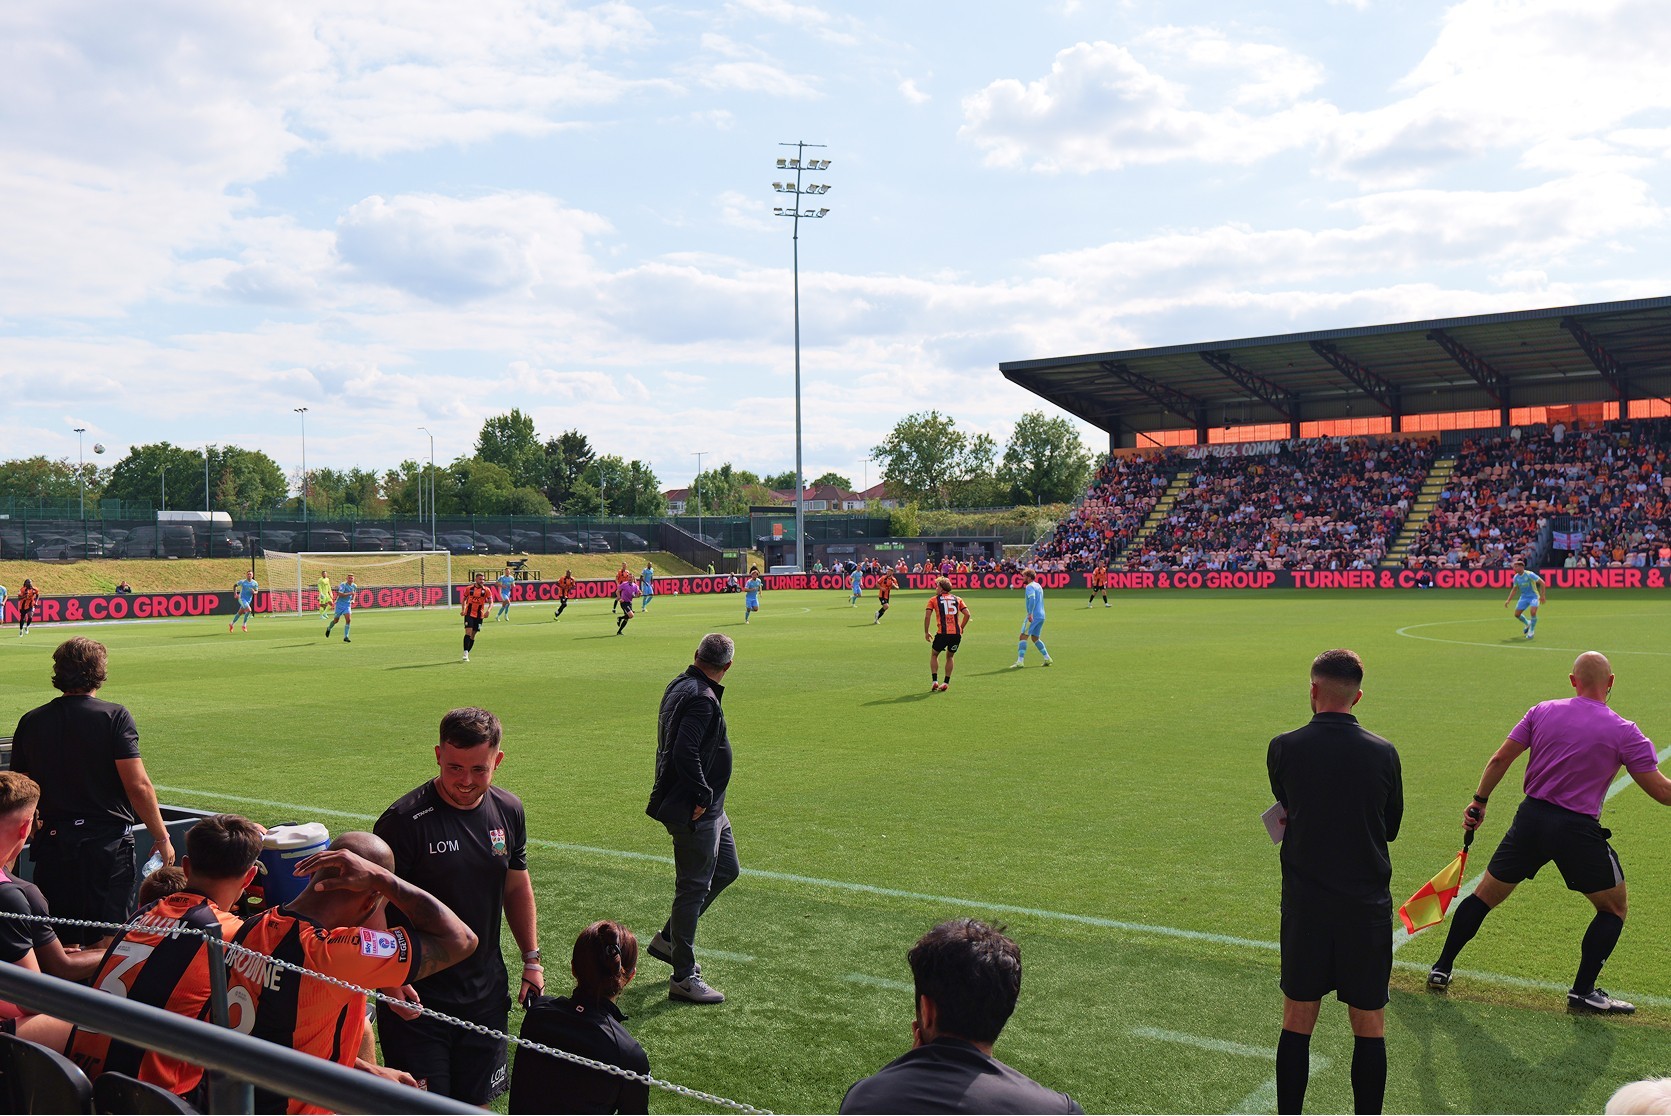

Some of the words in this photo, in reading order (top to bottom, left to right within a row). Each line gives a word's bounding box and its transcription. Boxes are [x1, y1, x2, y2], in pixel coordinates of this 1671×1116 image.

[682, 578, 691, 594] &
[693, 577, 712, 593] CO
[764, 575, 807, 590] TURNER
[810, 575, 819, 589] &
[821, 574, 842, 589] CO
[906, 573, 967, 589] TURER
[970, 573, 981, 589] &
[983, 573, 1008, 589] CO
[1011, 572, 1070, 589] GOUP
[1083, 572, 1154, 588] TRNER
[1157, 572, 1170, 588] &
[1173, 571, 1200, 588] CO
[1206, 571, 1276, 588] GROUP
[1291, 570, 1375, 588] TURNER
[1380, 570, 1394, 588] &
[1435, 569, 1514, 588] GROUP
[1540, 568, 1641, 588] TURNER
[1646, 568, 1665, 588] &
[254, 591, 320, 613] URNER
[378, 587, 443, 607] GROUP
[525, 584, 537, 601] &
[5, 600, 60, 623] NER
[66, 598, 84, 620] &
[88, 597, 128, 619] CO
[133, 594, 219, 617] GROUP
[940, 600, 958, 615] 15
